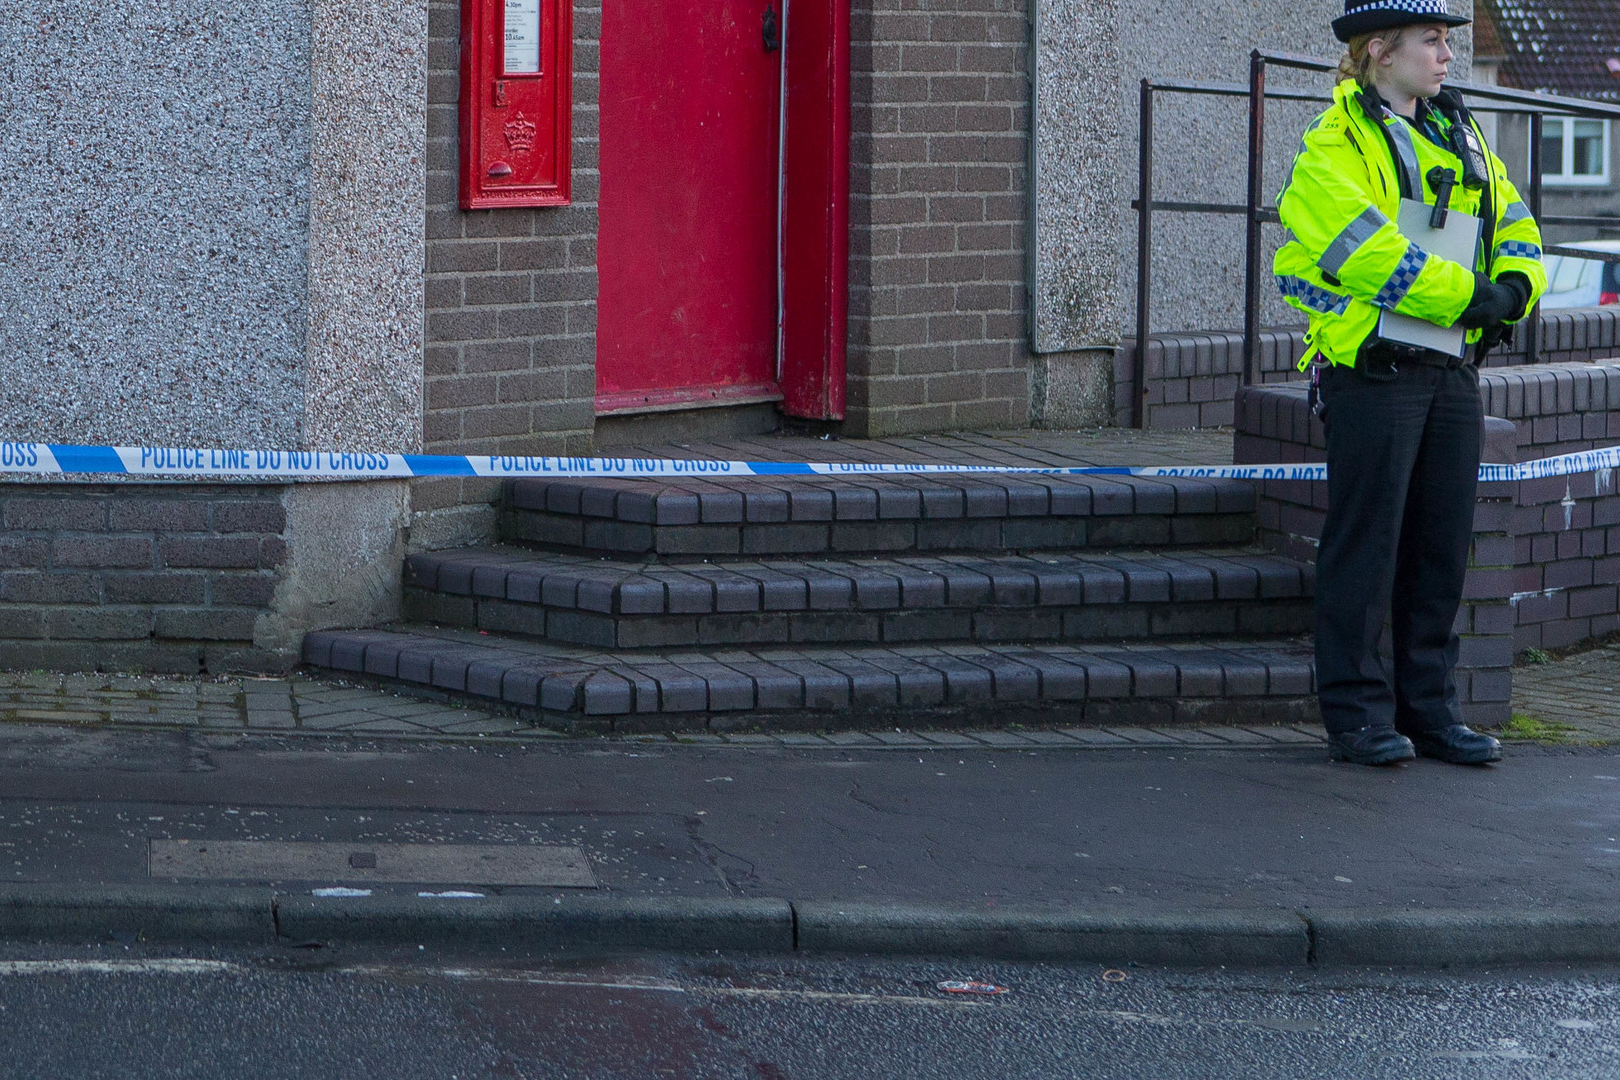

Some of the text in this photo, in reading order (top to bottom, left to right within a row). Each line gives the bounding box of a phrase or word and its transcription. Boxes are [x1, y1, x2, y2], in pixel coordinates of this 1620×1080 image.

[141, 447, 389, 471] POLICE LINE DO NOT CROSS
